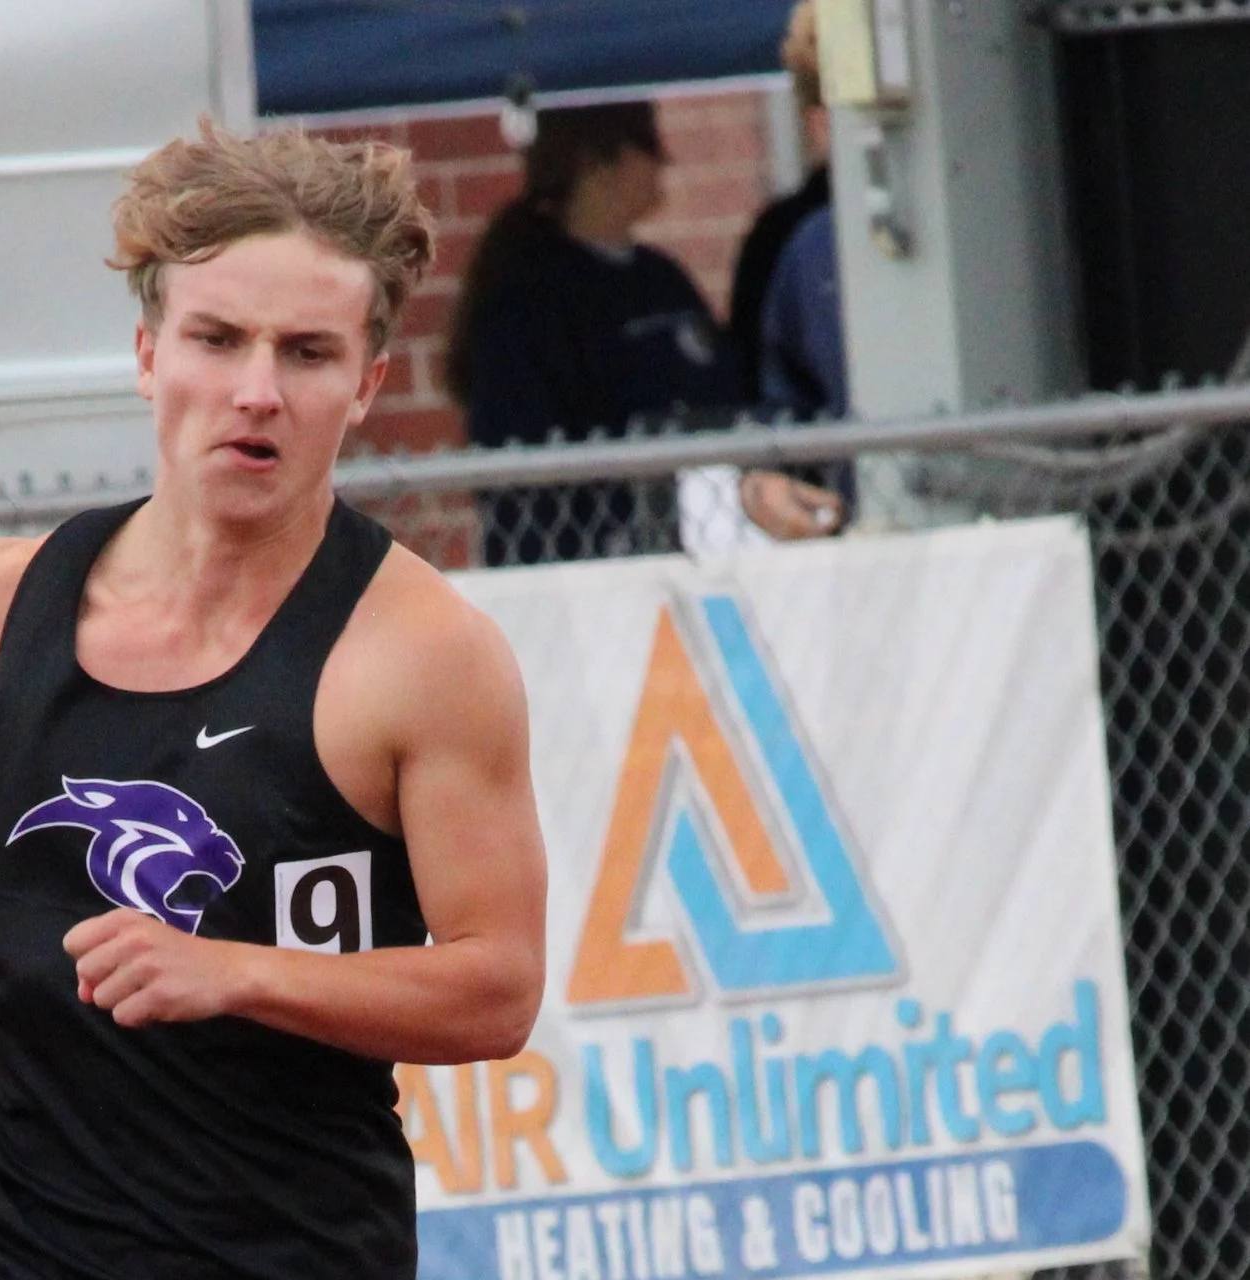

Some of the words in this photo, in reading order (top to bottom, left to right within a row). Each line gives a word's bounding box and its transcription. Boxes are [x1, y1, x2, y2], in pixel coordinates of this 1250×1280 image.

[290, 865, 360, 954] 9
[584, 978, 1107, 1179] Unlimited
[741, 1197, 777, 1270] &
[795, 1162, 1017, 1261] COOLING
